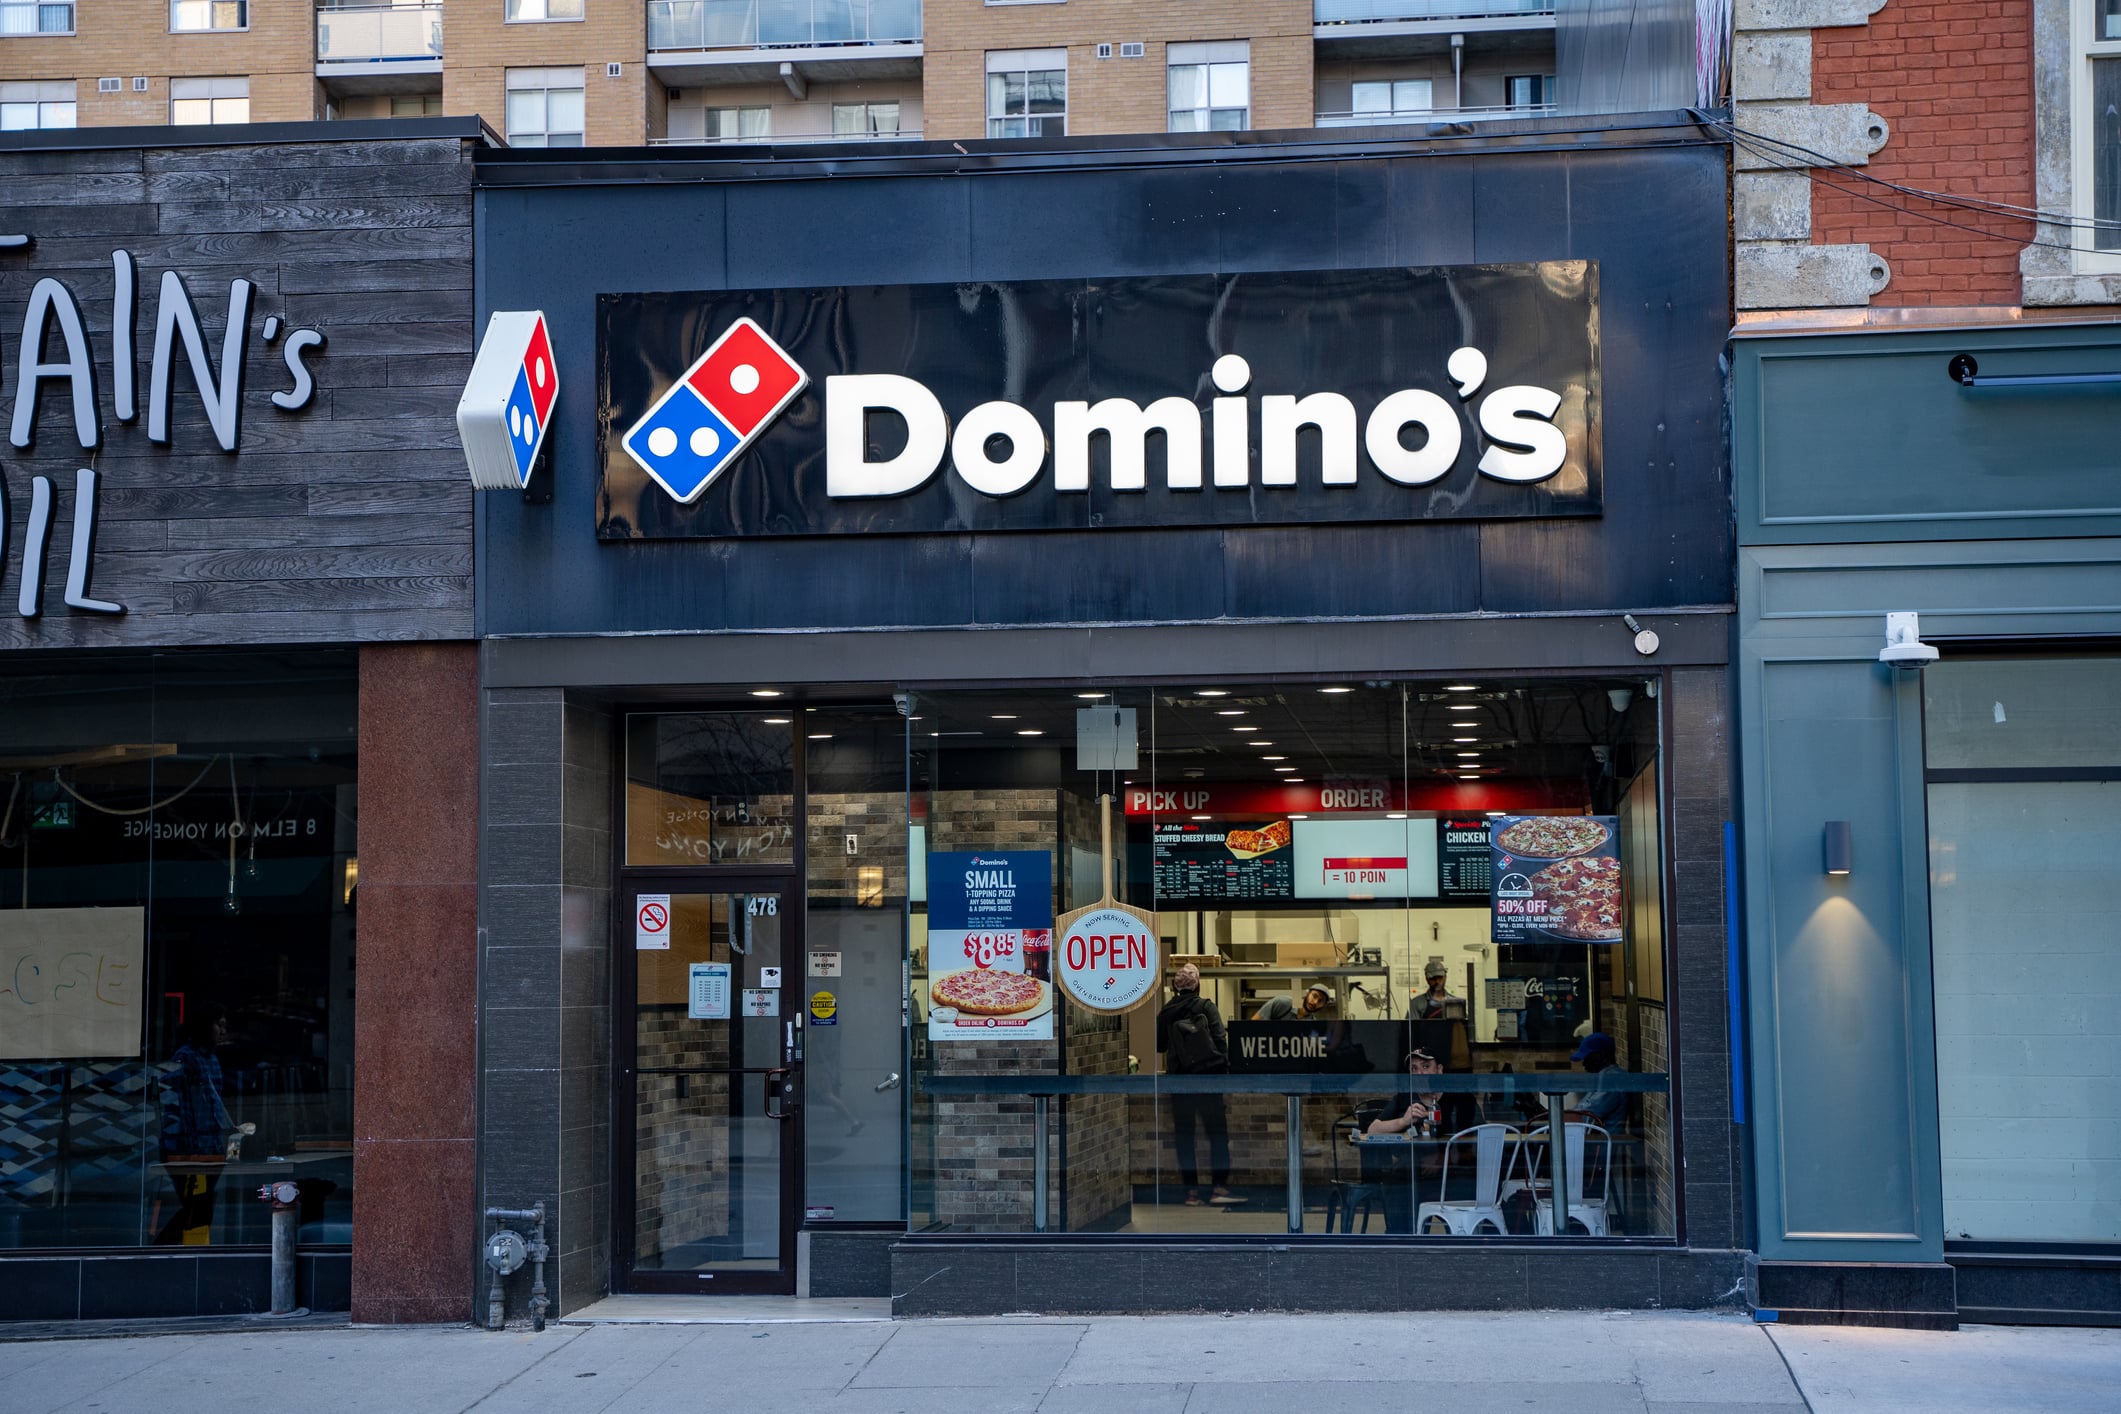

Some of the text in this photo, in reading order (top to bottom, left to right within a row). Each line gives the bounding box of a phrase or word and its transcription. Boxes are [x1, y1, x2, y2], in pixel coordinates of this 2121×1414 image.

[0, 234, 327, 453] AIN's
[826, 346, 1567, 498] Domino's
[0, 468, 127, 617] IL
[1133, 791, 1210, 811] PICK UP
[1321, 788, 1385, 808] ORDER
[1154, 833, 1225, 843] STUFFED CHEESY BREAD
[1446, 831, 1486, 843] CHICKEN
[979, 858, 1009, 866] Domino's
[965, 870, 1017, 889] SMALL
[1343, 872, 1356, 884] 10
[966, 889, 1016, 898] 1-TOPPING PIZZA
[748, 896, 777, 916] 478
[1498, 899, 1548, 914] 50% OFF
[1085, 914, 1130, 929] NOW SERVING
[1066, 934, 1147, 971] OPEN
[1112, 978, 1145, 1003] GOODNESS
[1240, 1035, 1328, 1058] WELCOME
